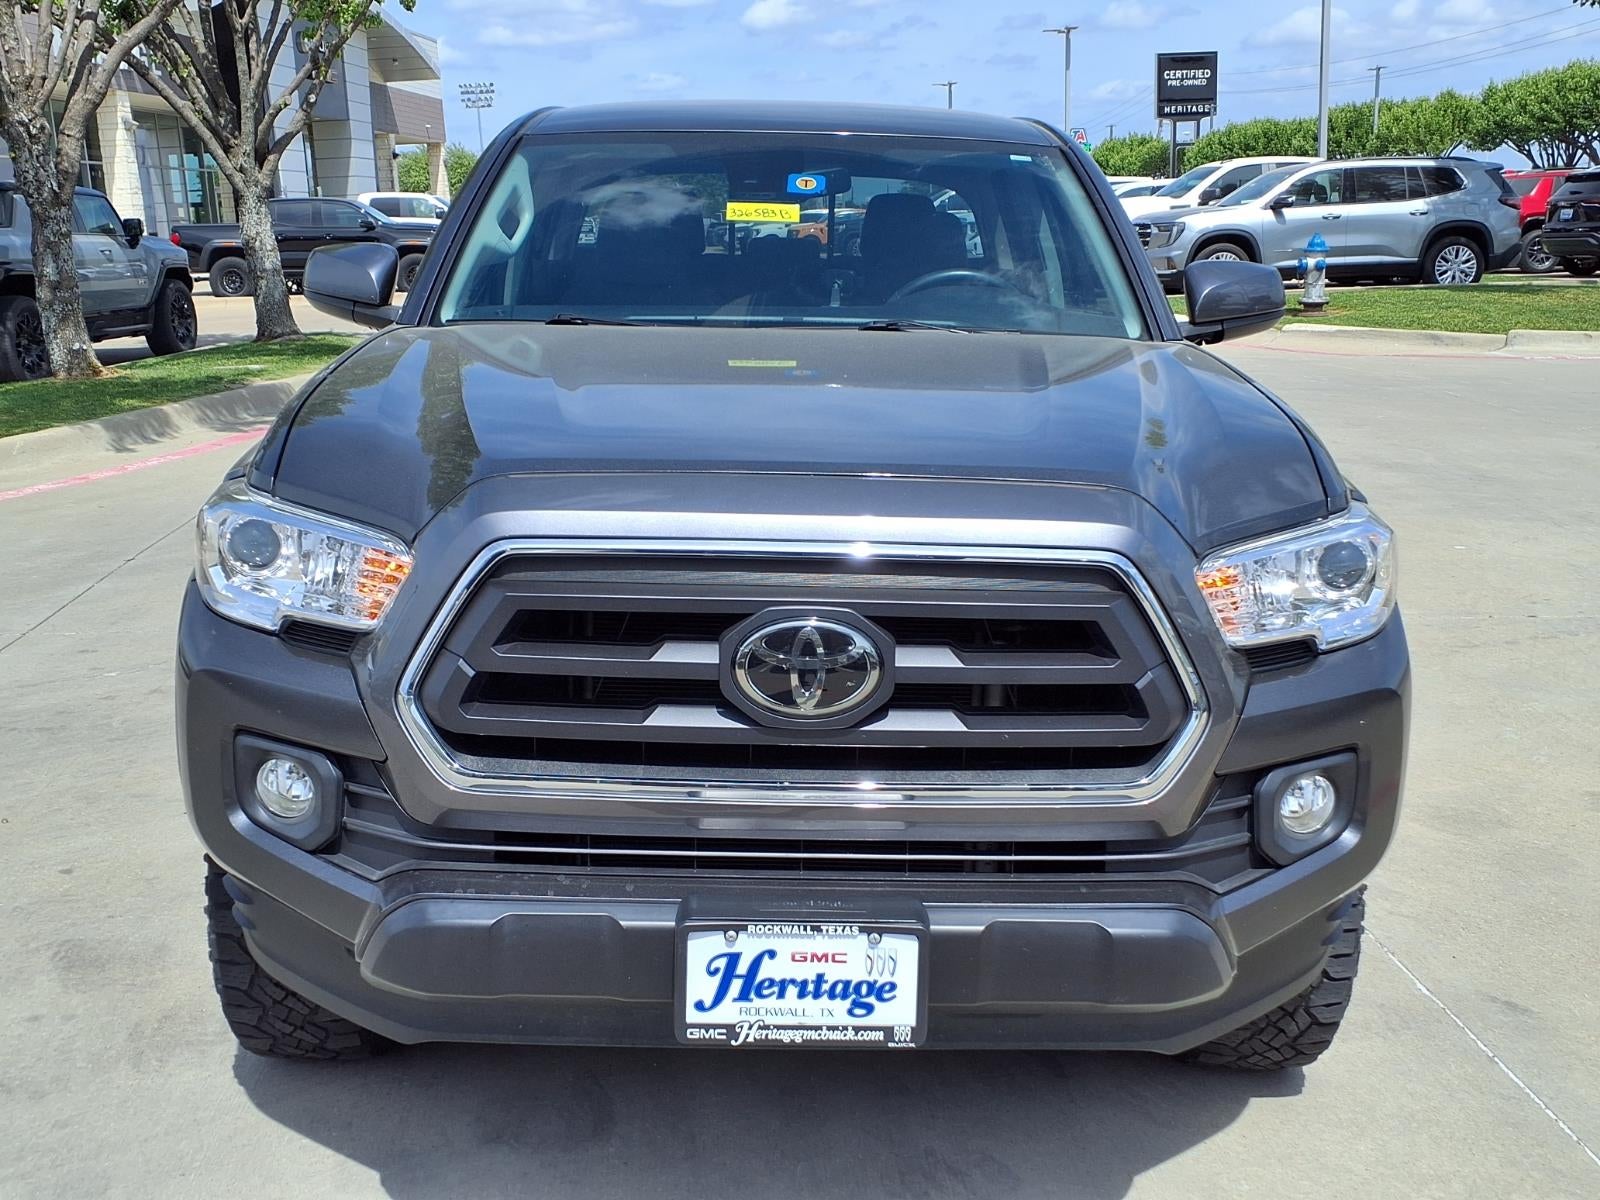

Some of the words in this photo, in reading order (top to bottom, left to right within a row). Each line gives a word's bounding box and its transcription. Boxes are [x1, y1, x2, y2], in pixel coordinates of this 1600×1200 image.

[1164, 69, 1211, 79] CERTIFIED
[1164, 105, 1210, 114] HERITAGE
[747, 925, 818, 936] ROCKWALL,
[820, 925, 860, 936] TEXAS
[790, 951, 848, 964] GMC
[693, 948, 898, 1018] Heritage
[820, 1008, 835, 1018] TX
[686, 1028, 727, 1039] GMC
[730, 1019, 885, 1046] Heritagegmcbuick.com
